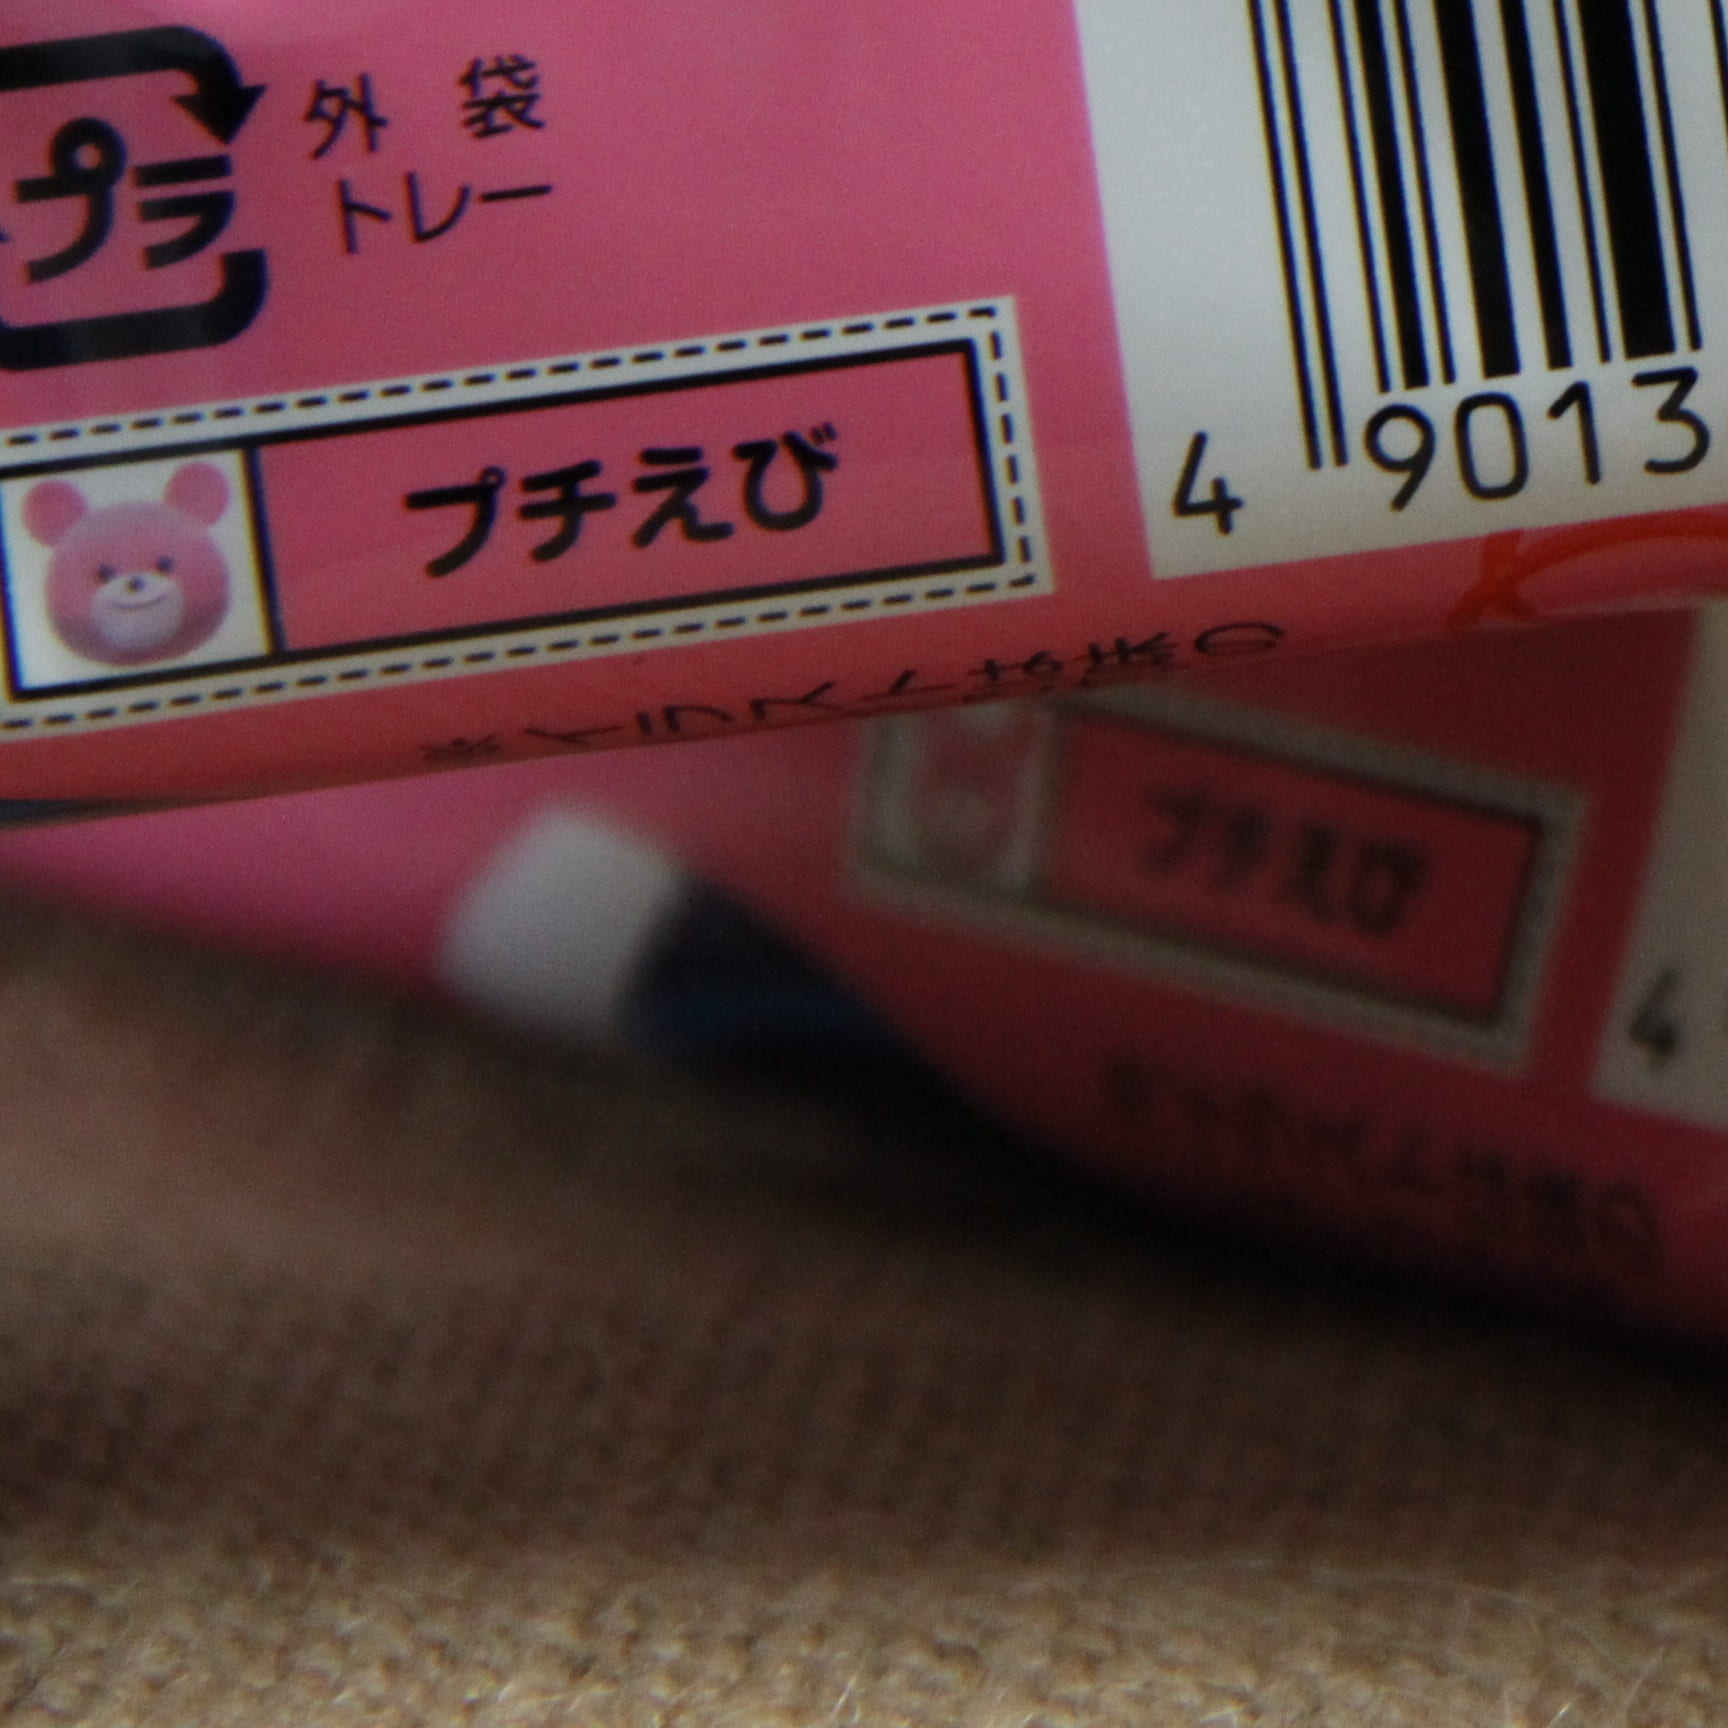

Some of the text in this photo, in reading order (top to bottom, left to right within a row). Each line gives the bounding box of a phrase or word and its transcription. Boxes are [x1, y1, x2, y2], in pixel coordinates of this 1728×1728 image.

[14, 117, 236, 284] プラ
[341, 171, 553, 254] トレー
[405, 423, 841, 578] プチえび
[1172, 431, 1245, 536] 4
[1624, 969, 1681, 1073] 4
